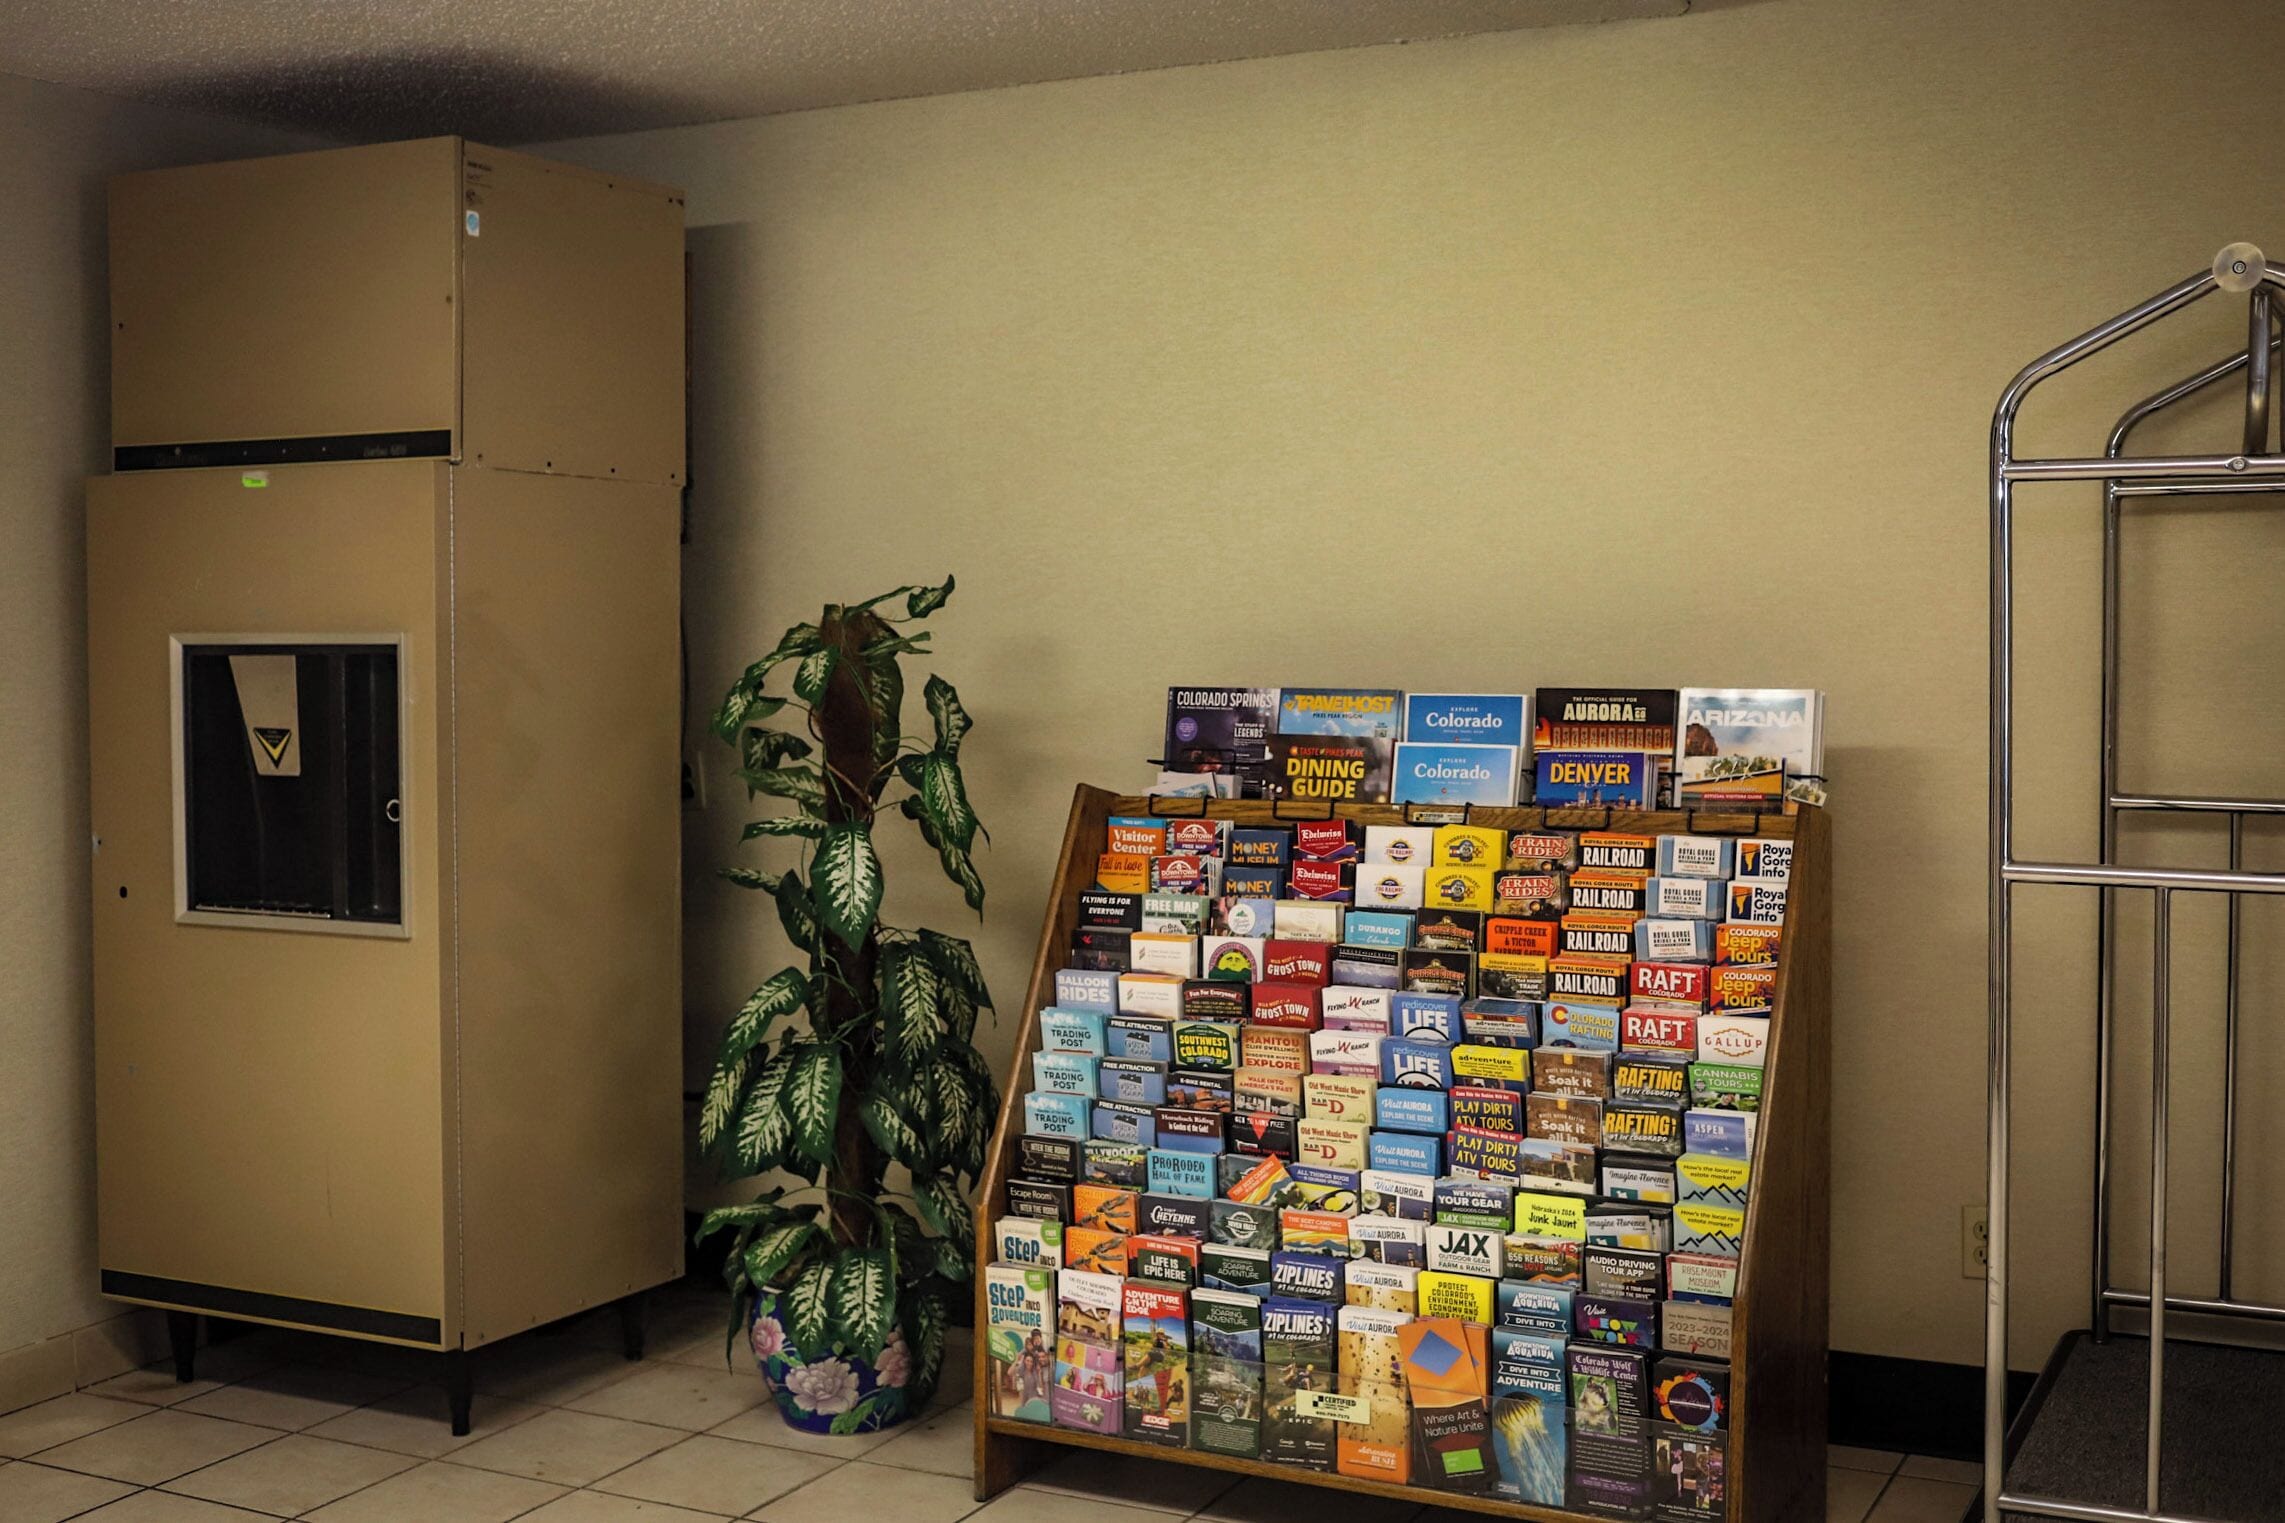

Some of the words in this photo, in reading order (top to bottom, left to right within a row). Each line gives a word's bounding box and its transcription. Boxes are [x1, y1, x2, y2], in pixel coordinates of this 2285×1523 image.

[1177, 692, 1227, 706] COLORADO
[1230, 693, 1272, 707] SPRINGS
[1563, 703, 1634, 721] AURORA
[1687, 709, 1804, 727] ARIZONA
[1426, 712, 1502, 728] Colorado
[1234, 728, 1263, 738] LEGENDS
[1287, 759, 1364, 780] DINING
[1414, 763, 1490, 780] Colorado
[1550, 763, 1631, 784] DENVER
[1292, 779, 1355, 798] GUIDE
[1114, 829, 1156, 842] Visitor
[1519, 836, 1563, 847] TRAIN
[1112, 841, 1157, 854] Center
[1232, 843, 1279, 854] MONEY
[1515, 847, 1562, 857] RIDES
[1678, 848, 1696, 856] ROYAL
[1582, 847, 1644, 867] RAILROAD
[1762, 866, 1785, 878] info
[1504, 876, 1550, 888] TRAIN
[1505, 887, 1551, 898] RIDES
[1573, 888, 1634, 909] RAILROAD
[1088, 907, 1125, 916] EVERYONE
[1145, 899, 1172, 911] FREE
[1174, 900, 1199, 912] MAP
[1753, 911, 1777, 922] info
[1358, 924, 1400, 935] DURANGO
[1729, 928, 1779, 938] COLORADO
[1567, 932, 1627, 952] RAILROAD
[1720, 932, 1762, 949] Jeep
[1727, 947, 1772, 964] Tours
[1268, 962, 1295, 976] GHOST
[1296, 960, 1322, 973] TOWN
[1058, 975, 1109, 988] BALLOON
[1638, 968, 1696, 993] RAFT
[1723, 972, 1772, 983] COLORADO
[1555, 974, 1616, 996] RAILROAD
[1714, 976, 1756, 994] Jeep
[1058, 987, 1110, 1003] RIDES
[1648, 989, 1685, 999] COLORADO
[1721, 992, 1766, 1008] Tours
[1255, 1004, 1284, 1019] GHOST
[1284, 1006, 1309, 1018] TOWN
[1111, 1020, 1128, 1028] FREE
[1129, 1022, 1164, 1031] ATTRACTION
[1569, 1023, 1615, 1040] RAFTING
[1627, 1017, 1686, 1041] RAFT
[1051, 1029, 1092, 1040] TRADING
[1179, 1034, 1227, 1047] SOUTHWEST
[1246, 1036, 1300, 1046] MANITOU
[1061, 1038, 1084, 1048] POST
[1638, 1038, 1676, 1047] COLORADO
[1704, 1036, 1762, 1048] GALLUP
[1180, 1045, 1228, 1059] COLORADO
[1121, 1064, 1155, 1072] ATTRACTION
[1246, 1058, 1301, 1070] EXPLORE
[1044, 1071, 1084, 1082] TRADING
[1547, 1074, 1579, 1087] Soak
[1582, 1076, 1592, 1088] it
[1618, 1066, 1683, 1091] RAFTING
[1693, 1068, 1758, 1081] CANNABIS
[1053, 1081, 1076, 1090] POST
[1708, 1079, 1743, 1088] TOURS
[1116, 1104, 1151, 1114] ATTRACTION
[1454, 1100, 1480, 1113] PLAY
[1485, 1100, 1513, 1115] DIRTY
[1035, 1113, 1075, 1125] TRADING
[1605, 1112, 1671, 1136] RAFTING
[1044, 1123, 1067, 1132] POST
[1541, 1120, 1573, 1133] Soak
[1575, 1121, 1586, 1134] it
[1695, 1124, 1725, 1134] ASPEN
[1457, 1135, 1483, 1148] PLAY
[1485, 1138, 1518, 1157] DIRTY
[1456, 1150, 1476, 1164] ATV
[1482, 1156, 1516, 1172] TOURS
[1712, 1173, 1736, 1181] market?
[1010, 1187, 1031, 1198] Escape
[1032, 1190, 1052, 1200] Room
[1374, 1181, 1393, 1192] Visit
[1394, 1186, 1424, 1198] AURORA
[1438, 1195, 1469, 1206] YOUR
[1472, 1198, 1502, 1208] GEAR
[1150, 1205, 1196, 1224] CHEYENNE
[1529, 1213, 1549, 1225] Junk
[1552, 1216, 1577, 1229] Jaunt
[1439, 1231, 1491, 1258] JAX
[1151, 1255, 1168, 1268] LIFE
[1170, 1258, 1179, 1268] IS
[1438, 1254, 1467, 1262] OUTDOOR
[1508, 1253, 1523, 1262] 656
[1525, 1254, 1559, 1265] REASONS
[1590, 1254, 1616, 1265] AUDIO
[1618, 1256, 1656, 1271] DRIVING
[1144, 1265, 1163, 1278] EPIC
[1165, 1268, 1186, 1280] HERE
[1217, 1267, 1259, 1280] ADVENTURE
[1222, 1262, 1255, 1272] SOARING
[1466, 1264, 1491, 1273] RANCH
[1602, 1265, 1624, 1276] TOUR
[1626, 1268, 1644, 1278] APP
[1273, 1263, 1335, 1289] ZIPLINES
[1438, 1282, 1468, 1291] PROTECT
[1125, 1289, 1180, 1304] ADVENTURE
[1125, 1299, 1137, 1308] ON
[1429, 1304, 1462, 1313] ECONOMY
[1125, 1306, 1149, 1316] EDGE
[1210, 1308, 1243, 1318] SOARING
[1206, 1314, 1248, 1326] ADVENTURE
[1263, 1312, 1323, 1335] ZIPLINES
[1515, 1317, 1534, 1326] DIVE
[1535, 1318, 1556, 1328] INTO
[1669, 1333, 1729, 1350] SEASON
[1575, 1355, 1610, 1369] Colorado
[1612, 1360, 1632, 1372] Wolf
[1509, 1366, 1528, 1374] DIVE
[1530, 1368, 1550, 1377] INTO
[1581, 1365, 1611, 1378] Wildlife
[1613, 1370, 1638, 1381] Center
[1497, 1375, 1562, 1393] ADVENTURE
[1422, 1414, 1455, 1425] Where
[1457, 1412, 1471, 1421] Art
[1425, 1425, 1458, 1437] Nature
[1459, 1422, 1484, 1433] Unite
